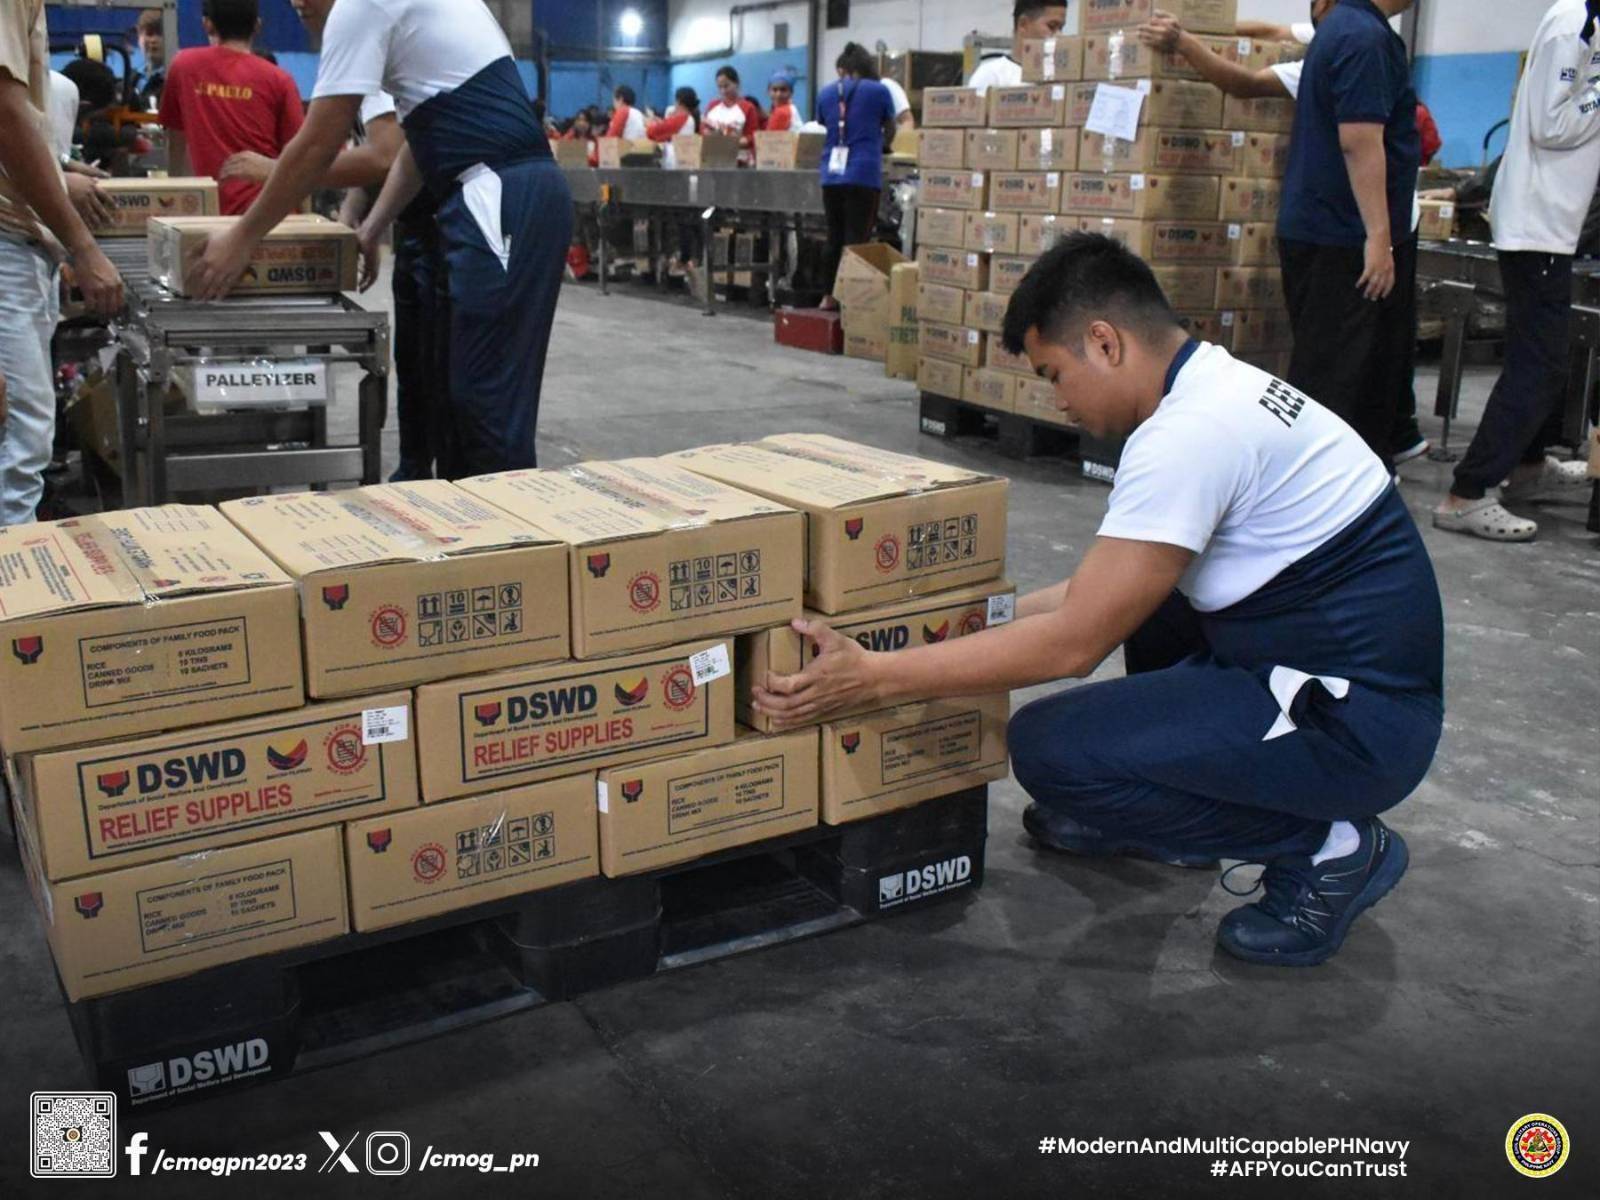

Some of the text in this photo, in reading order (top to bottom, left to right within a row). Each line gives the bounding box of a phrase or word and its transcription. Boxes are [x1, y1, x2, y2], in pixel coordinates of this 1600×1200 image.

[206, 373, 317, 387] PALLETIZER
[1258, 378, 1307, 428] FLEE
[451, 592, 465, 603] 10
[852, 625, 909, 652] SWD
[507, 684, 597, 724] DSWD
[474, 733, 540, 767] RELIEF
[545, 718, 633, 753] SUPPLIES
[137, 748, 246, 794] DSWD
[99, 804, 179, 843] RELIEF
[185, 783, 293, 825] SUPPLIES
[906, 855, 971, 894] DSWD
[169, 1038, 269, 1087] DSWD
